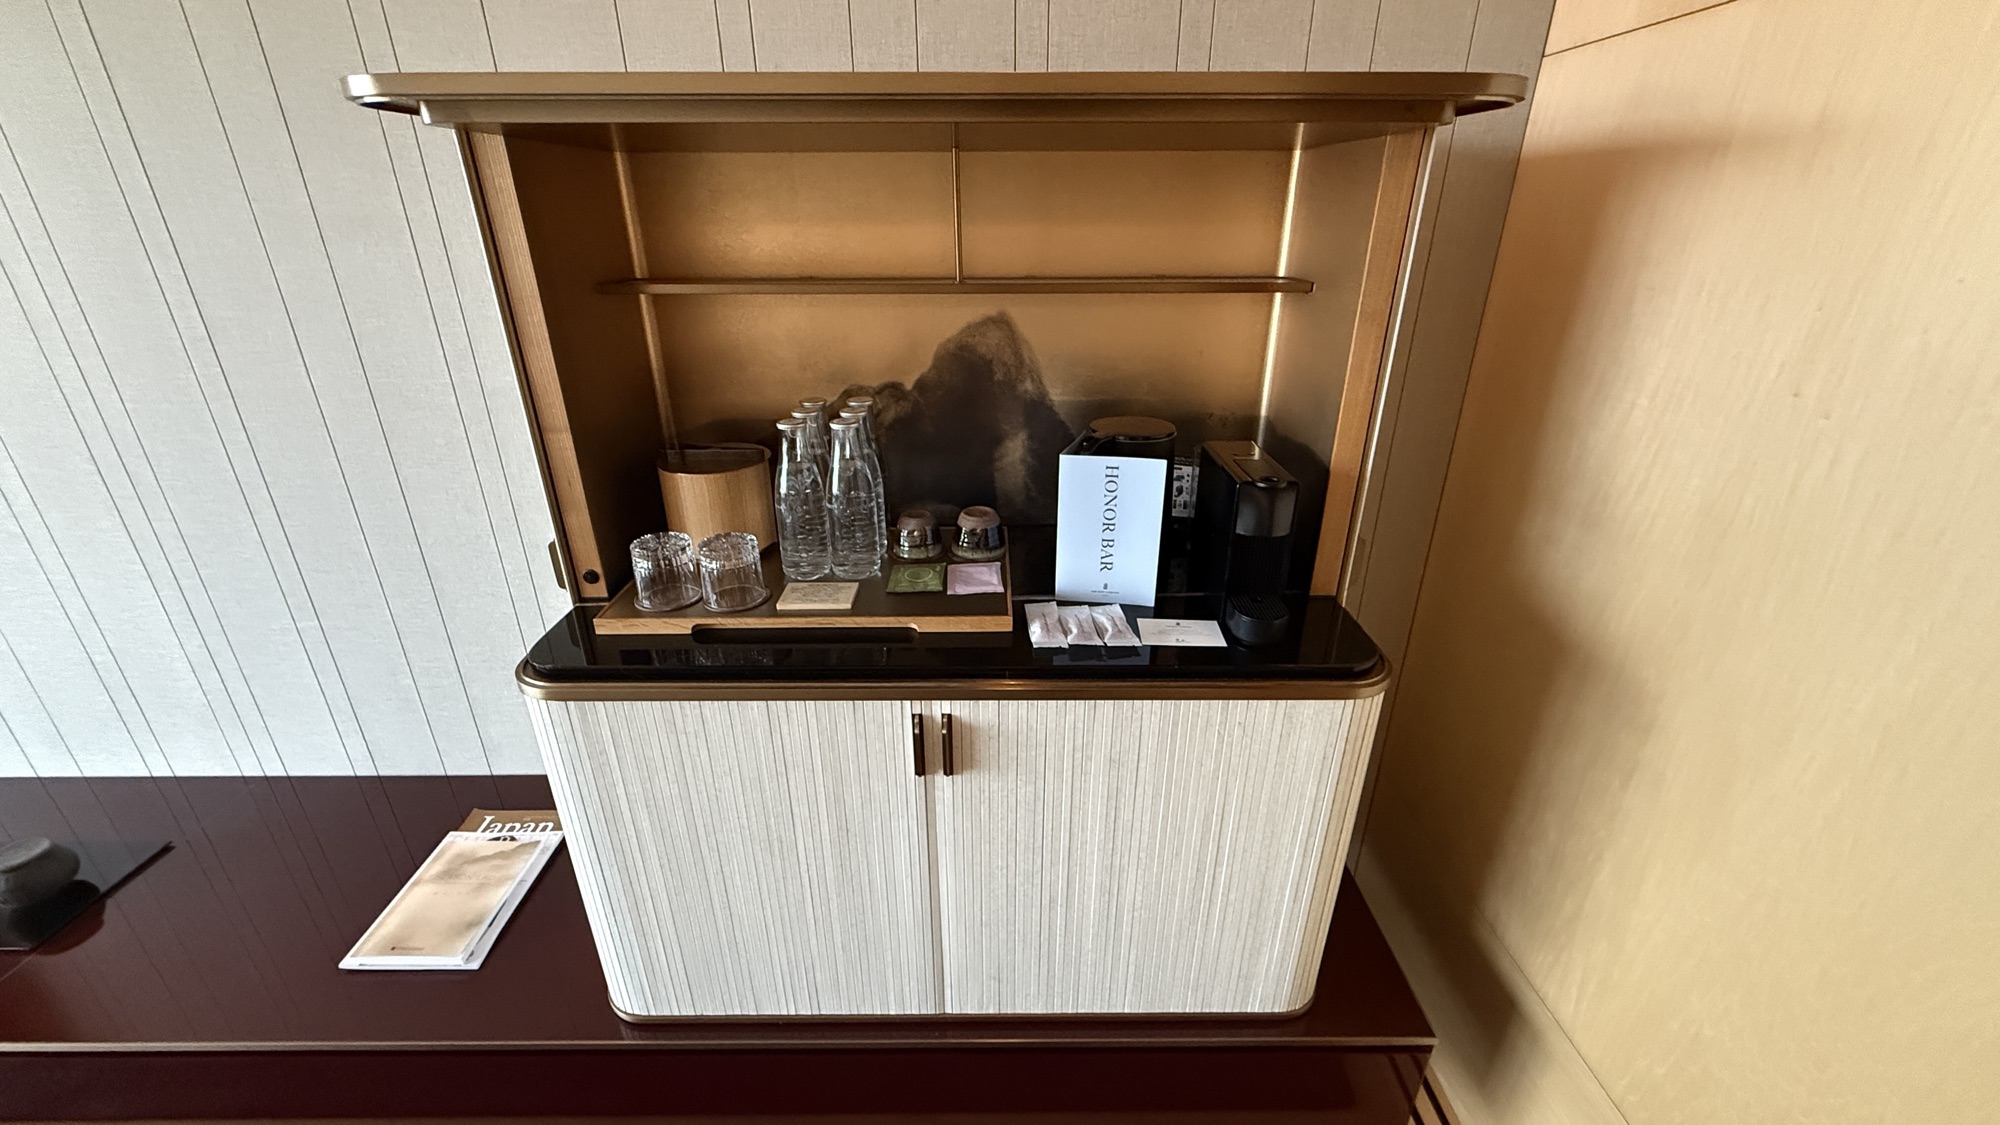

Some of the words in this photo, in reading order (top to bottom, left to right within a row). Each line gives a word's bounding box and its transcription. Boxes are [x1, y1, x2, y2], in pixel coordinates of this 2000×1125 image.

[1102, 465, 1119, 533] HONOR
[1100, 538, 1115, 572] BAR
[477, 815, 554, 833] Japan
